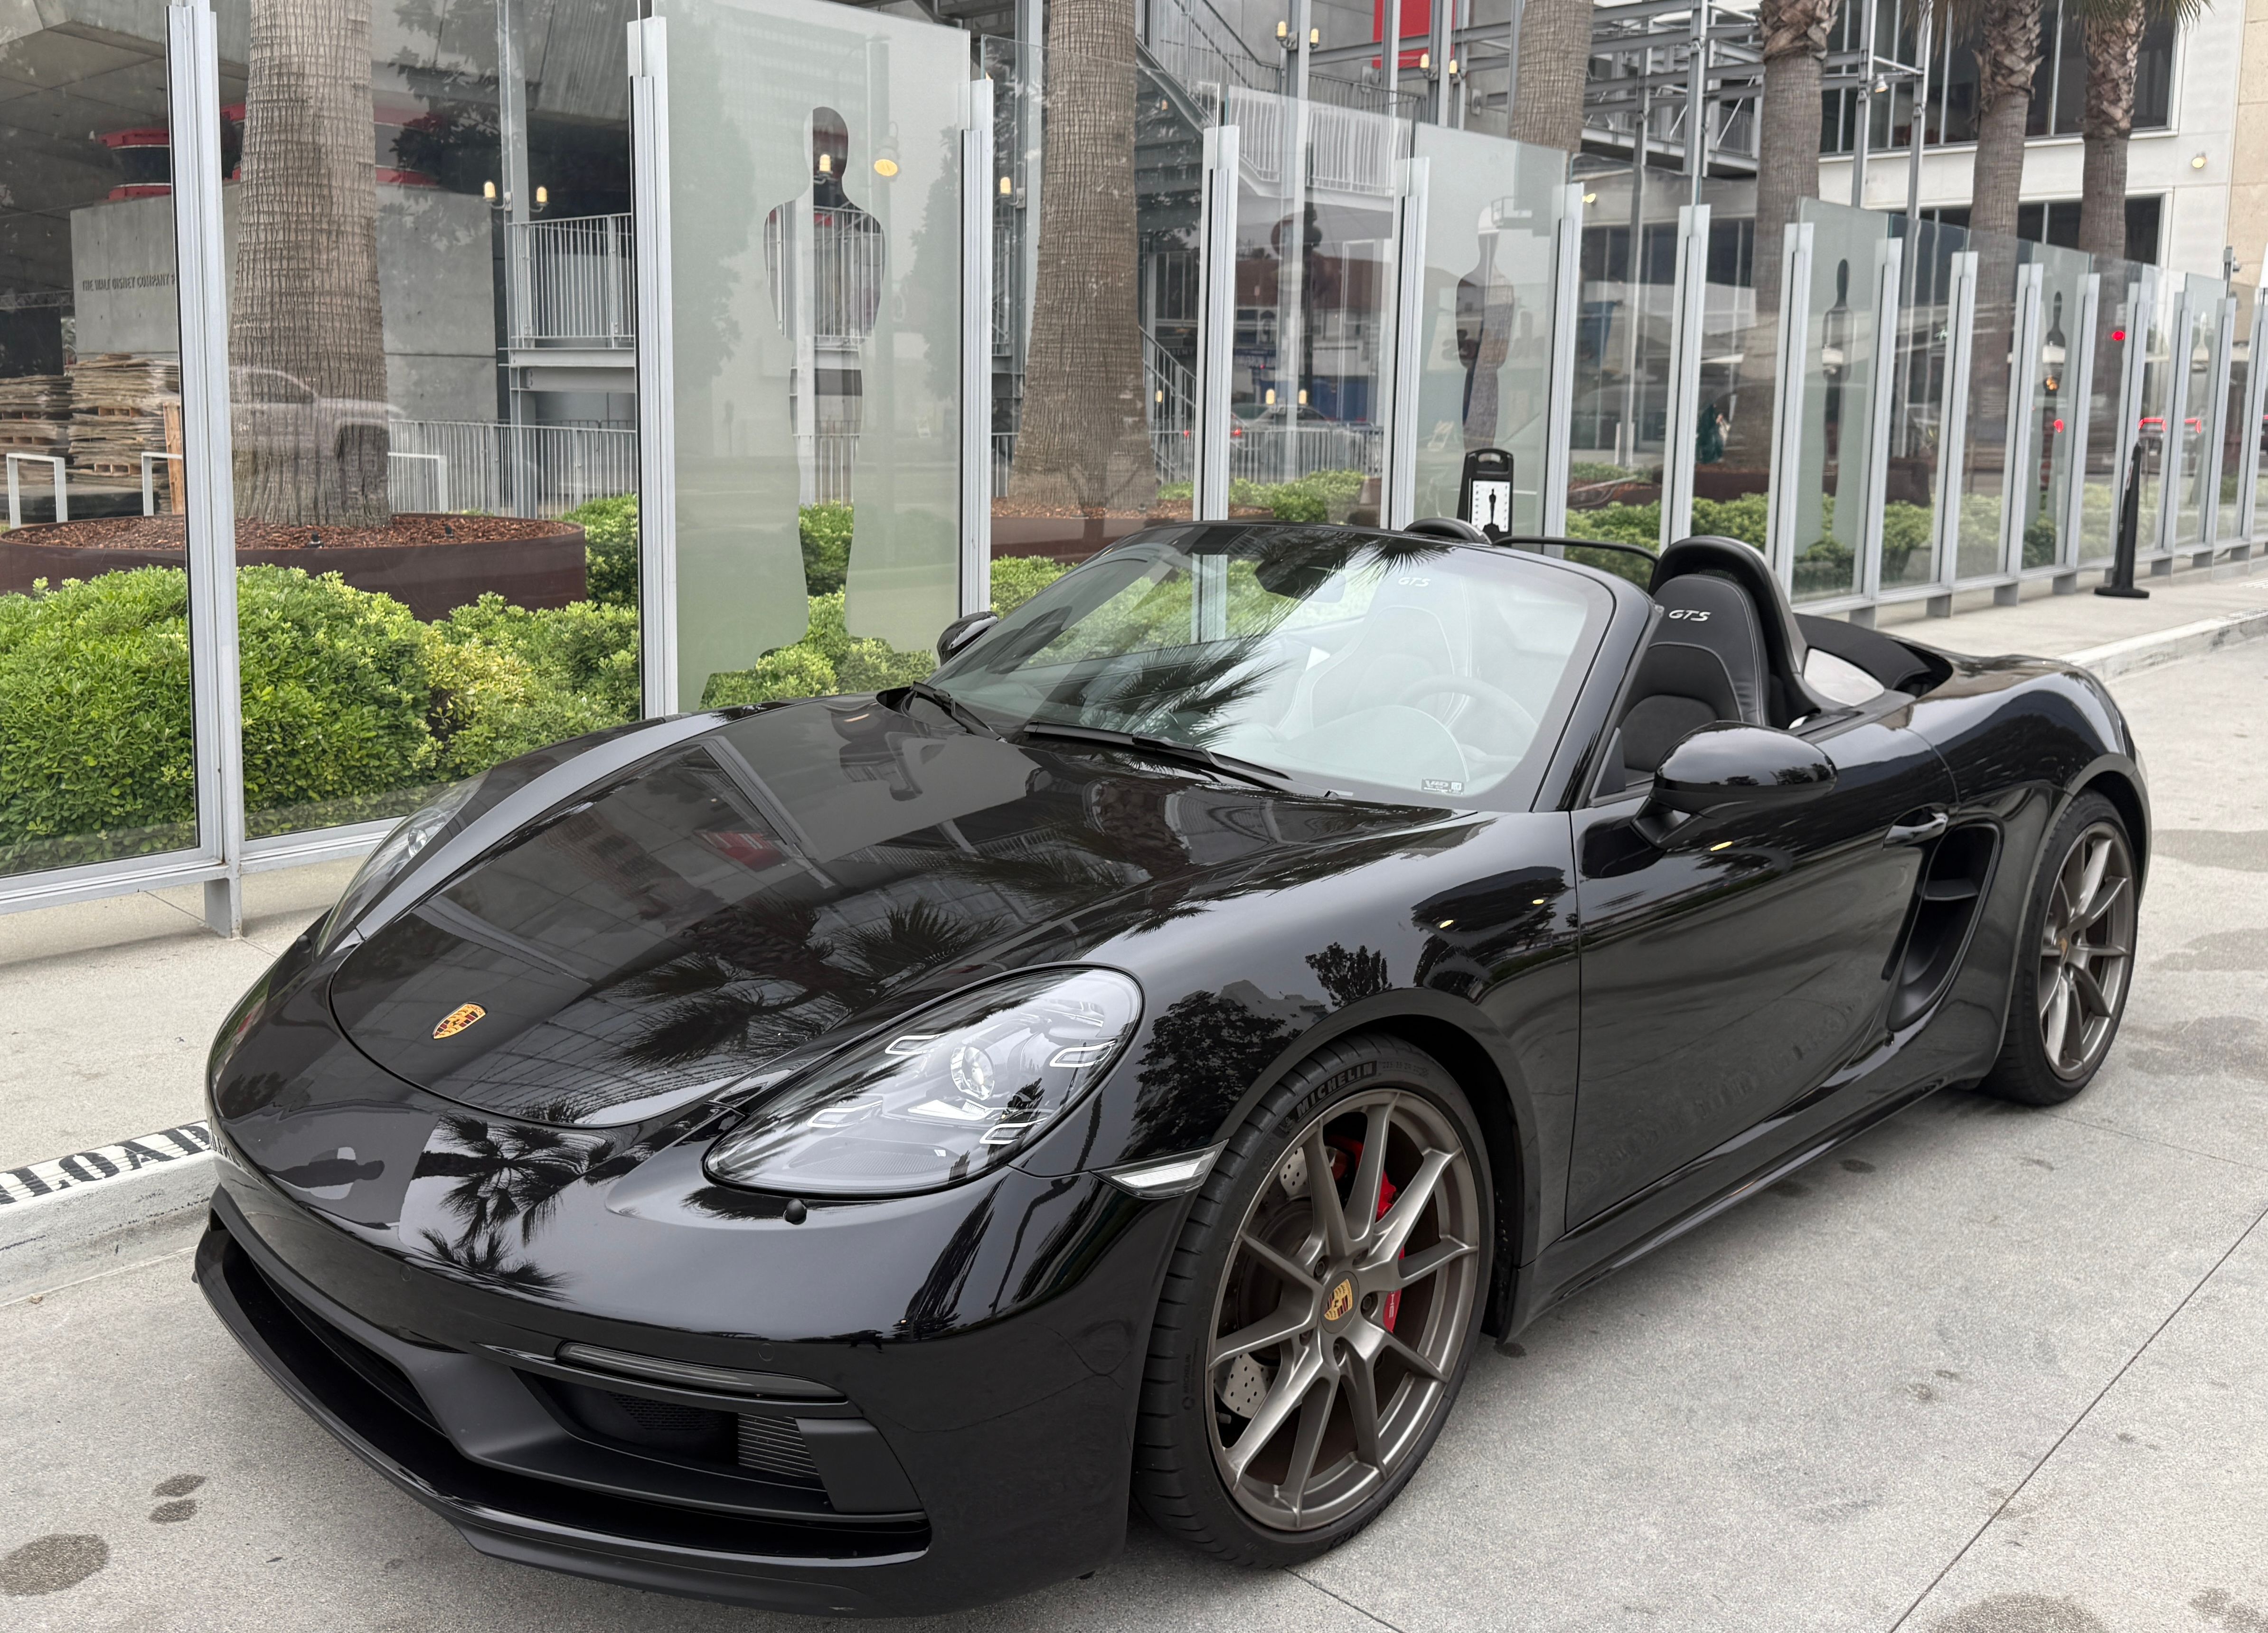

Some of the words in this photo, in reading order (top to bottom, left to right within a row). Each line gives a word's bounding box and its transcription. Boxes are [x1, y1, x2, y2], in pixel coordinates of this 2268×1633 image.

[83, 280, 94, 291] THE
[95, 278, 111, 291] WALT
[112, 276, 135, 290] DISNEY
[137, 273, 169, 288] COMPANY
[1398, 576, 1431, 587] GTS
[1669, 610, 1711, 621] GTS
[1296, 1061, 1373, 1118] MICHELIN
